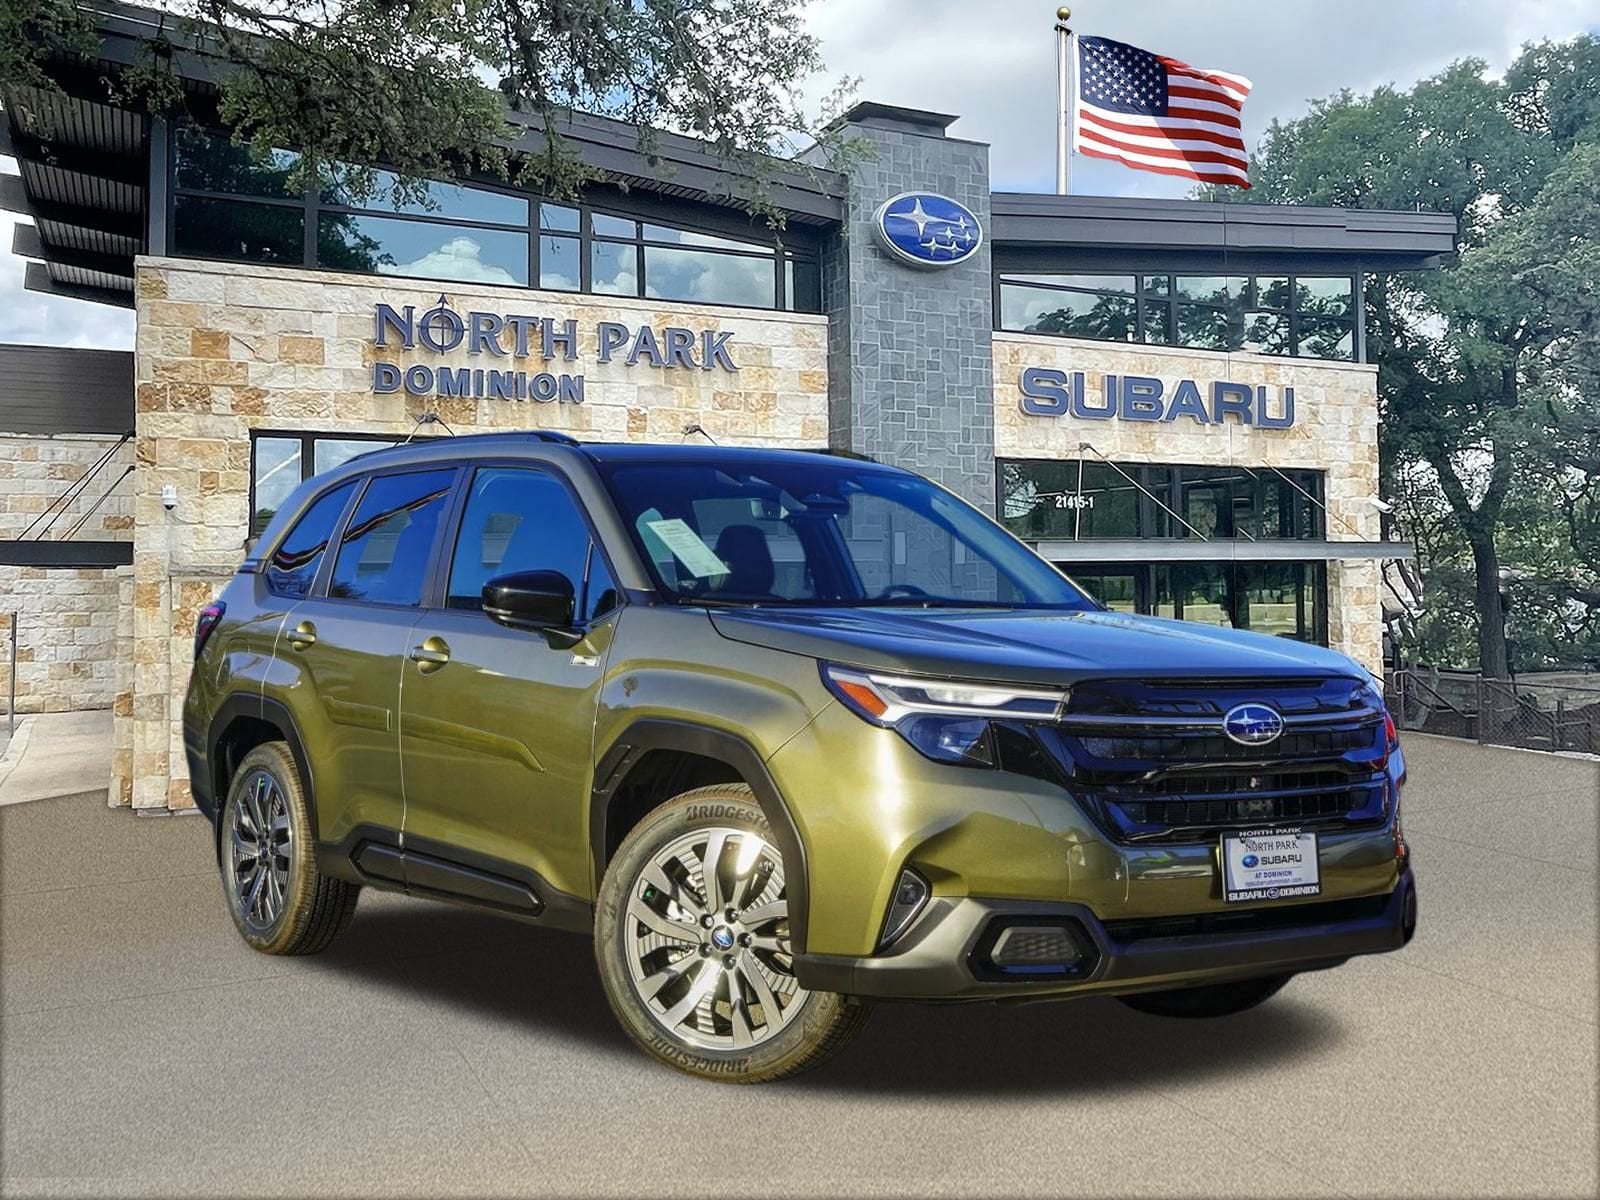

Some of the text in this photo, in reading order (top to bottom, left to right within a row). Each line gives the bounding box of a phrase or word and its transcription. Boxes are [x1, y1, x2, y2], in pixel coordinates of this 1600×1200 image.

[374, 292, 741, 373] NORTH PARK
[372, 361, 586, 405] DOMINION
[1018, 366, 1296, 430] SUBARU
[1055, 495, 1094, 509] 21415-1
[686, 804, 771, 832] BRIDGESTO
[1245, 840, 1299, 852] NORTH PARK
[1260, 854, 1302, 865] SUBARU
[1263, 870, 1293, 878] DOMINION
[1228, 885, 1320, 901] SUBARU DOMINION
